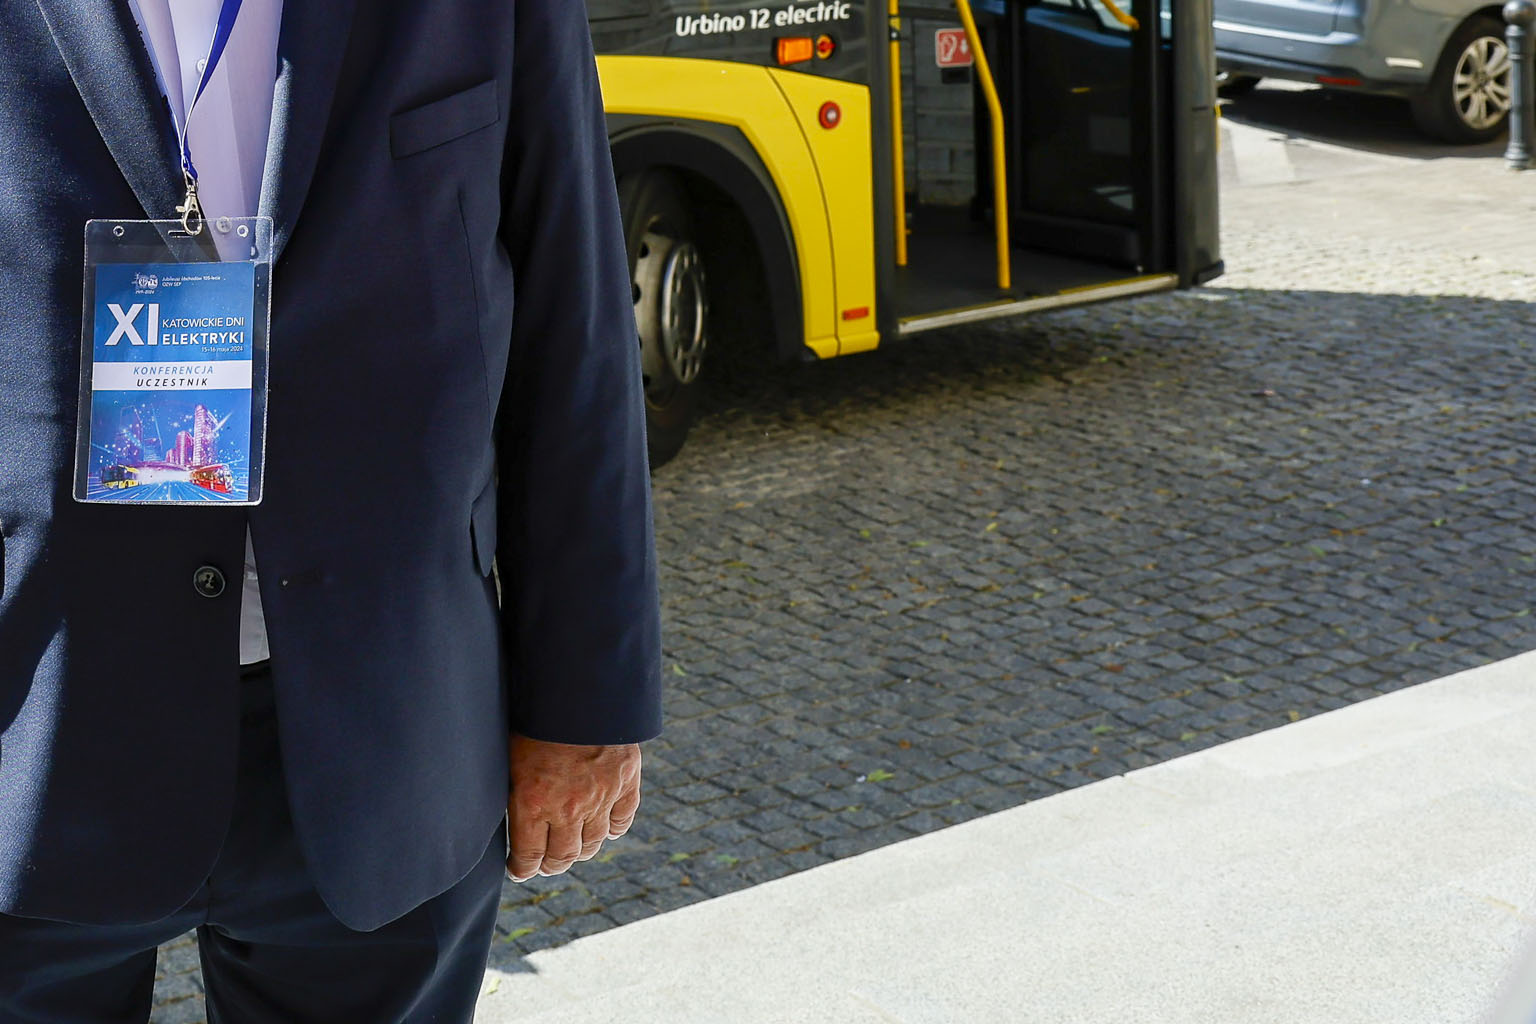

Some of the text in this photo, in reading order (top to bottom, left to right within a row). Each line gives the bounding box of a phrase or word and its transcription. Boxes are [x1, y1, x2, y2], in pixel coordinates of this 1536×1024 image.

[675, 0, 851, 37] Urbino 12 electric
[104, 303, 160, 346] XI
[162, 316, 245, 328] KATOWICKIE DNI
[162, 331, 245, 345] ELEKTRYKI
[133, 365, 214, 375] KONFERENCJA
[136, 378, 208, 387] UCZESTNIK
